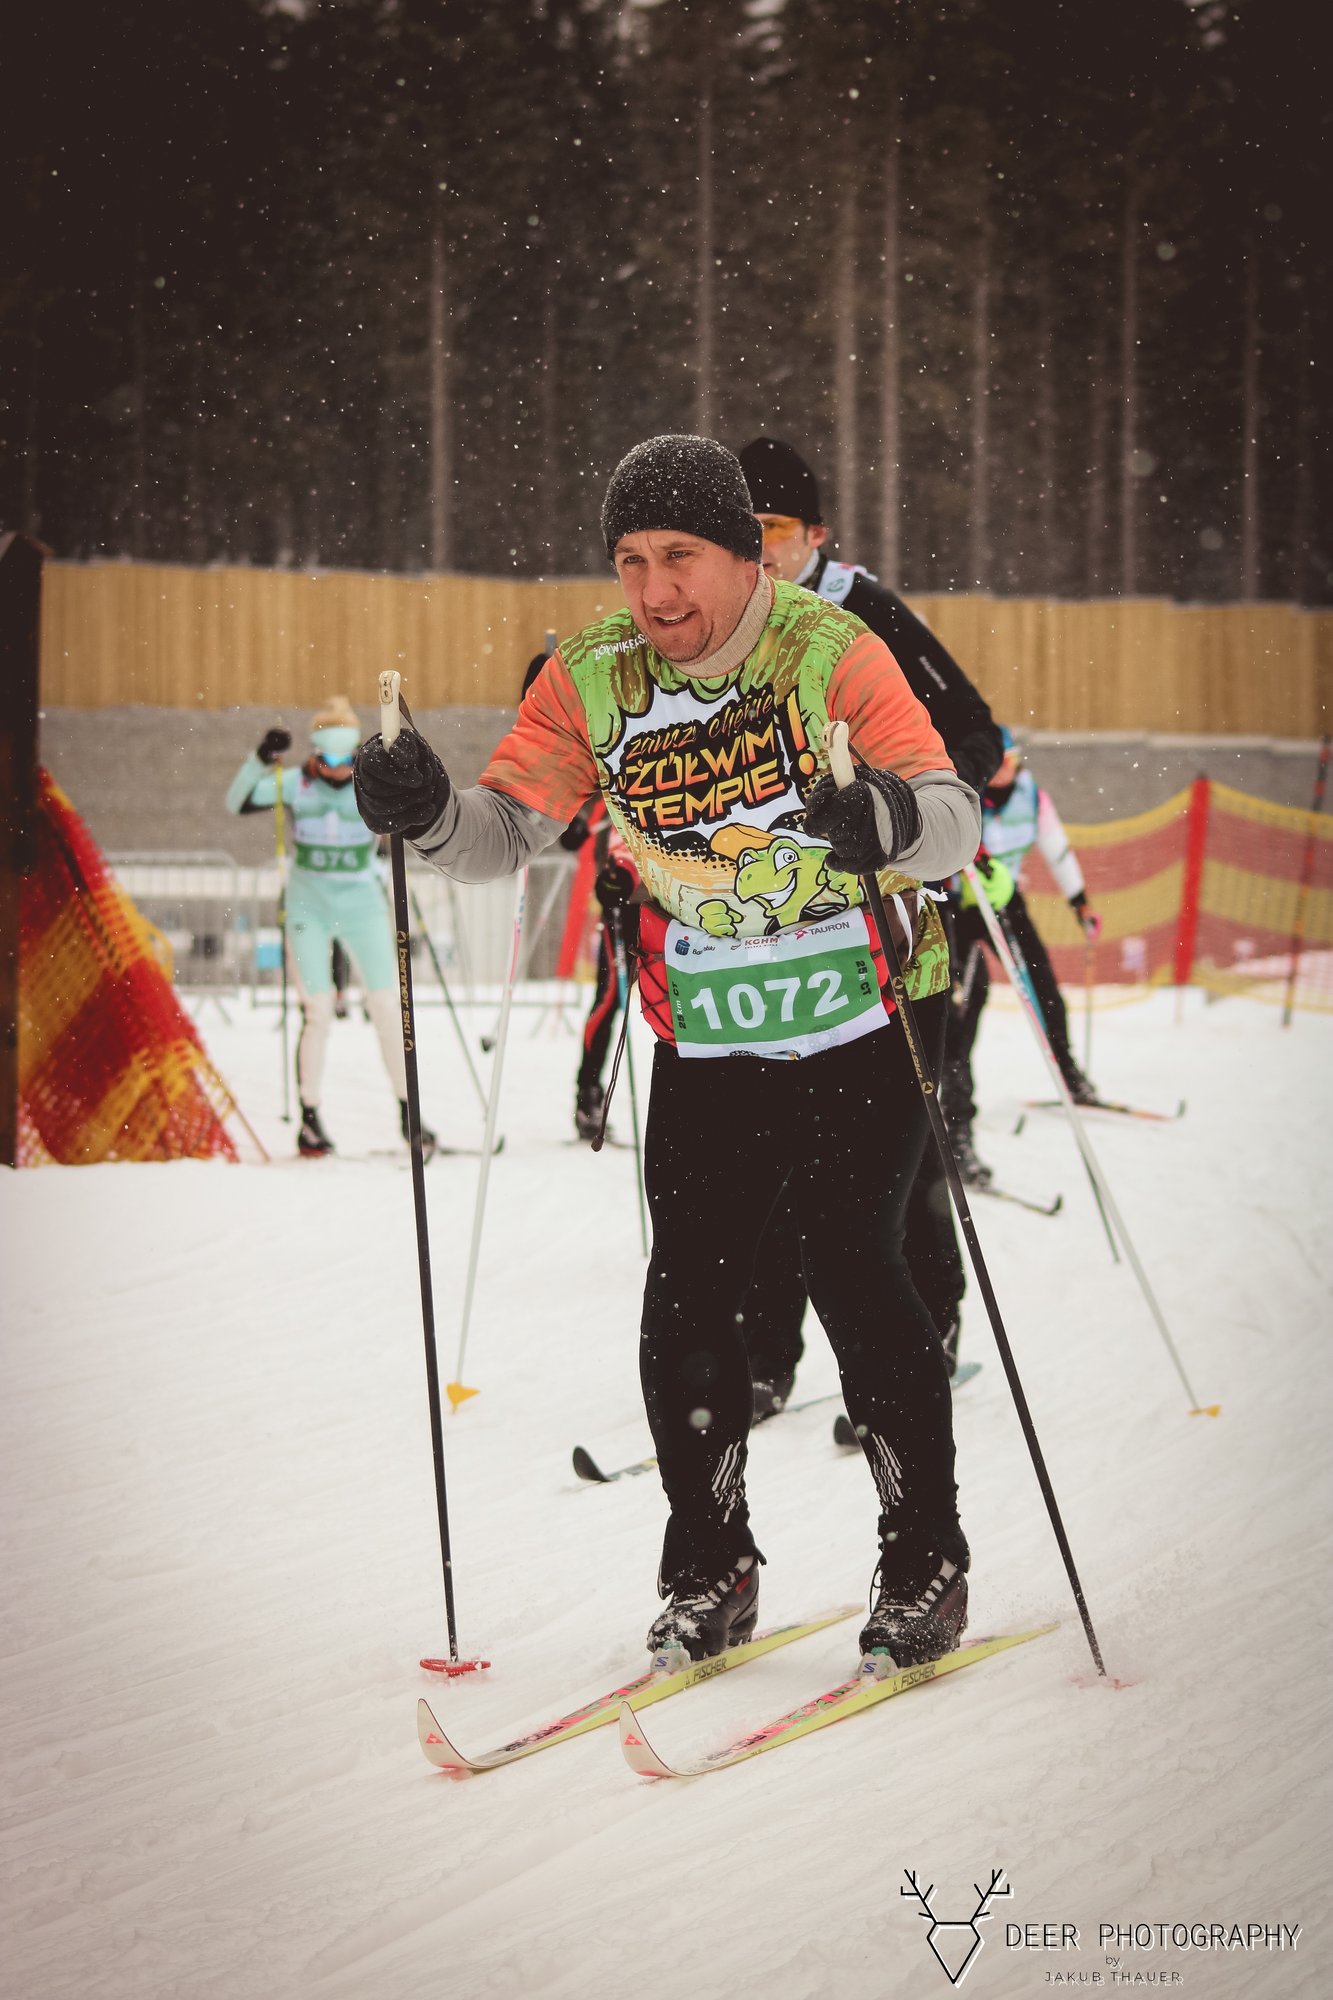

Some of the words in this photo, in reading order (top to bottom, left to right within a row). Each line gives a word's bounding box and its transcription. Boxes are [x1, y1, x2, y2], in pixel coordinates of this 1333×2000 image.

[626, 721, 776, 796] ŻÓŁWIM
[630, 758, 786, 828] TEMPIE
[809, 921, 850, 936] TAURON
[744, 937, 779, 946] KGHM
[690, 969, 850, 1030] 1072
[693, 1657, 728, 1682] FISCHER
[900, 1664, 936, 1689] FISCHER
